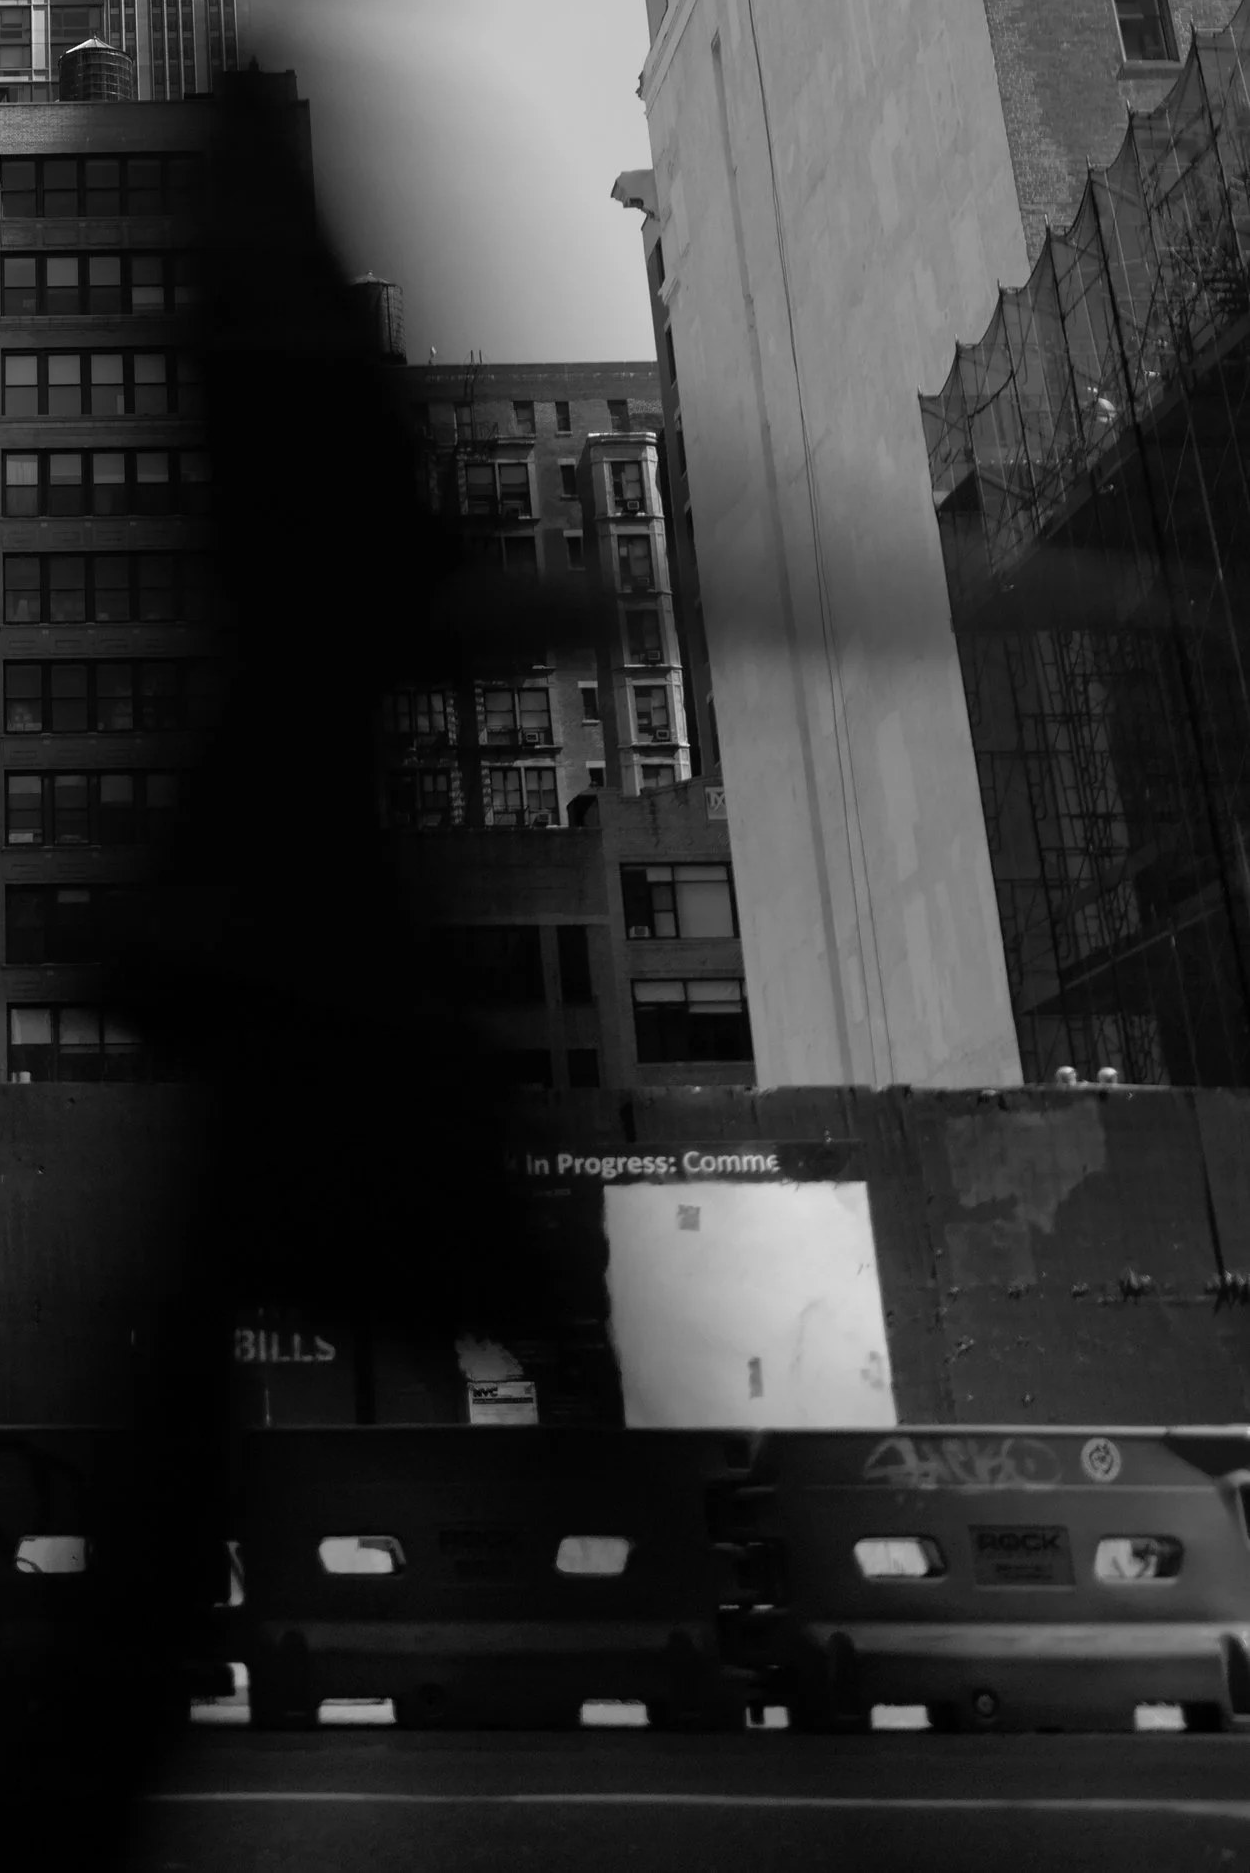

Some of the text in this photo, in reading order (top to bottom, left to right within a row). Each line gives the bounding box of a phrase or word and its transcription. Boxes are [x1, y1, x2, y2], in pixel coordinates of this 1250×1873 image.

[526, 1153, 550, 1176] In
[556, 1152, 678, 1180] Progress:
[234, 1326, 336, 1363] BILLS
